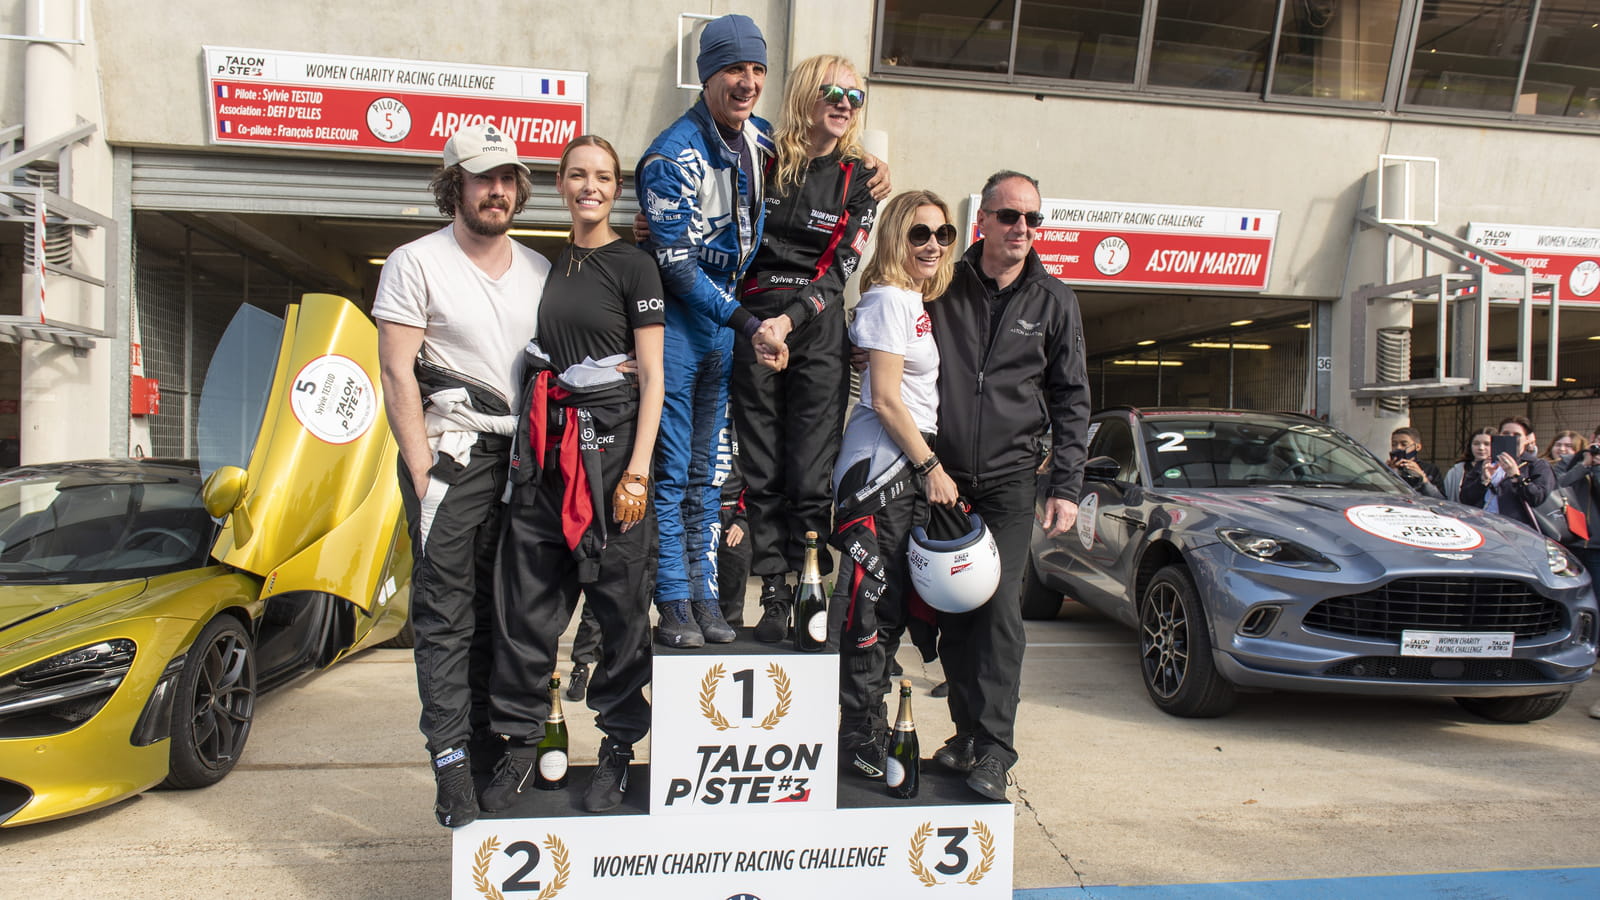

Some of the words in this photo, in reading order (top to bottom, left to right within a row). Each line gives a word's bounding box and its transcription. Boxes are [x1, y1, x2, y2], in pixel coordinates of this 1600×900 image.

[226, 56, 265, 67] TALON
[306, 63, 346, 79] WOMEN
[350, 66, 395, 83] CHARITY
[397, 70, 435, 86] RACING
[438, 73, 496, 90] CHALLENGE
[262, 88, 289, 102] Sylvie
[291, 90, 323, 104] TESTUD
[267, 105, 286, 119] DEFI
[372, 101, 404, 115] PILOTE
[385, 113, 393, 130] 5
[278, 125, 313, 140] François
[315, 127, 359, 141] DELECOUR
[500, 116, 576, 145] INTERIM
[1051, 208, 1085, 222] WOMEN
[1086, 210, 1122, 225] CHARITY
[1125, 213, 1157, 227] RACING
[1158, 214, 1204, 228] CHALLENGE
[1044, 231, 1079, 243] VIGNEAUX
[1100, 238, 1126, 251] PILOTE
[1537, 235, 1565, 247] WOMEN
[1108, 249, 1115, 264] 2
[1145, 249, 1197, 273] ASTON
[1200, 252, 1262, 276] MARTIN
[770, 275, 793, 286] Sylvie
[1319, 359, 1331, 369] 36
[296, 380, 316, 395] 5
[1156, 432, 1187, 453] 2
[732, 669, 754, 718] 1
[697, 744, 823, 773] TALON
[502, 840, 541, 892] 2
[593, 855, 658, 877] WOMEN
[662, 852, 732, 876] CHARITY
[734, 849, 795, 873] RACING
[800, 846, 888, 870] CHALLENGE
[934, 827, 969, 875] 3
